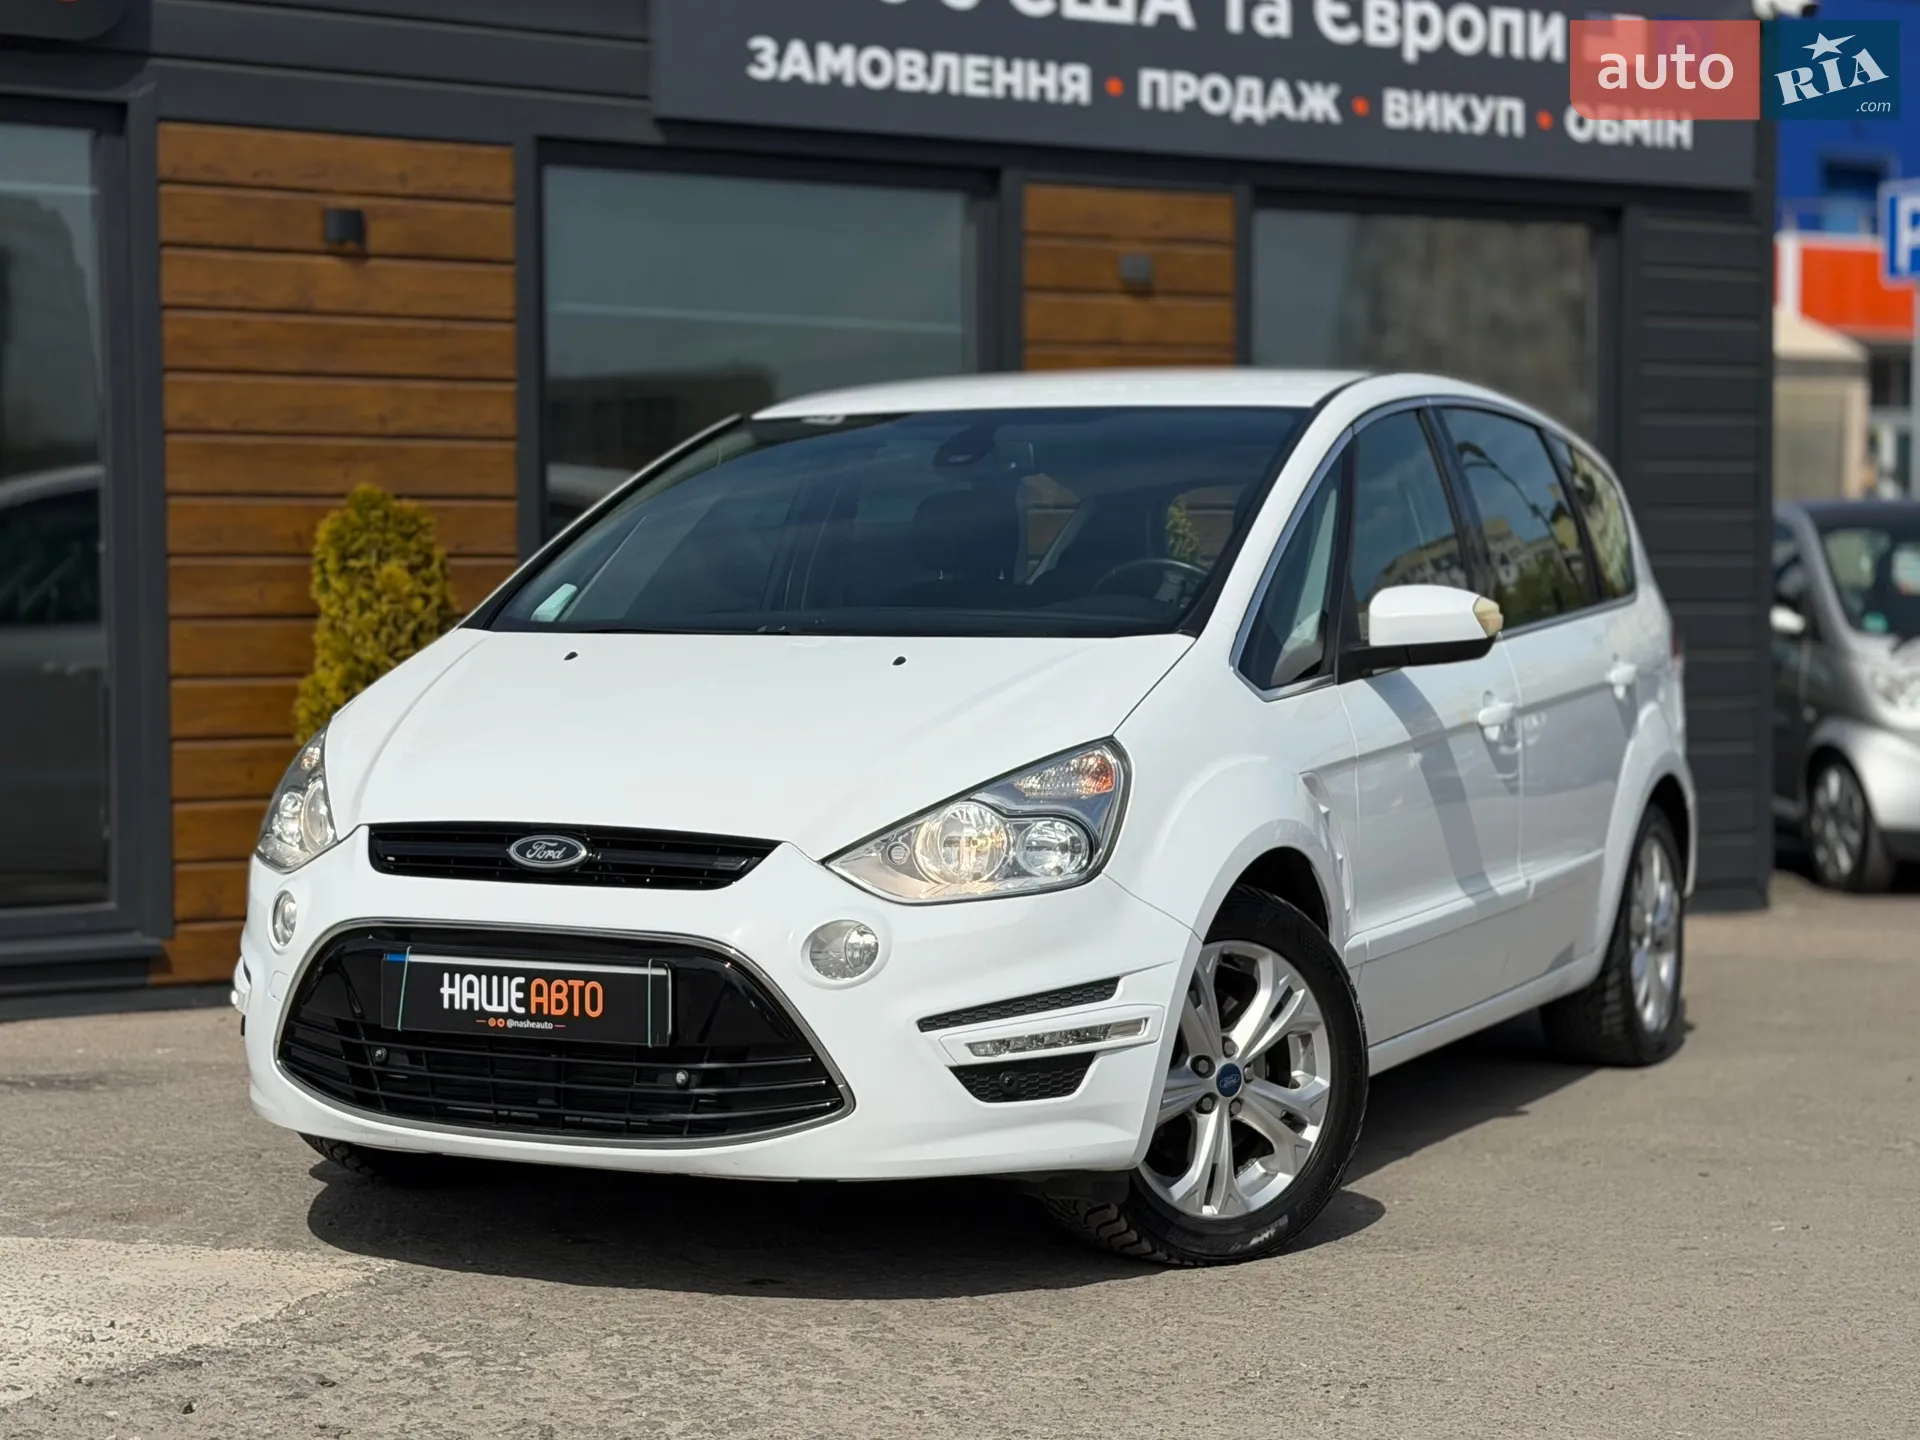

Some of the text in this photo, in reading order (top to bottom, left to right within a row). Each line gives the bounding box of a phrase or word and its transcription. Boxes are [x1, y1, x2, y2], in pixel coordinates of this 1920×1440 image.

[746, 36, 1092, 105] ЗАМОВЛЕННЯ
[1138, 68, 1342, 125] ПРОДАЖ
[1383, 87, 1526, 137] ВИКУП
[526, 840, 567, 859] Ford
[440, 972, 603, 1018] НАШЕ АВТО
[506, 1018, 553, 1030] @nasheauto
